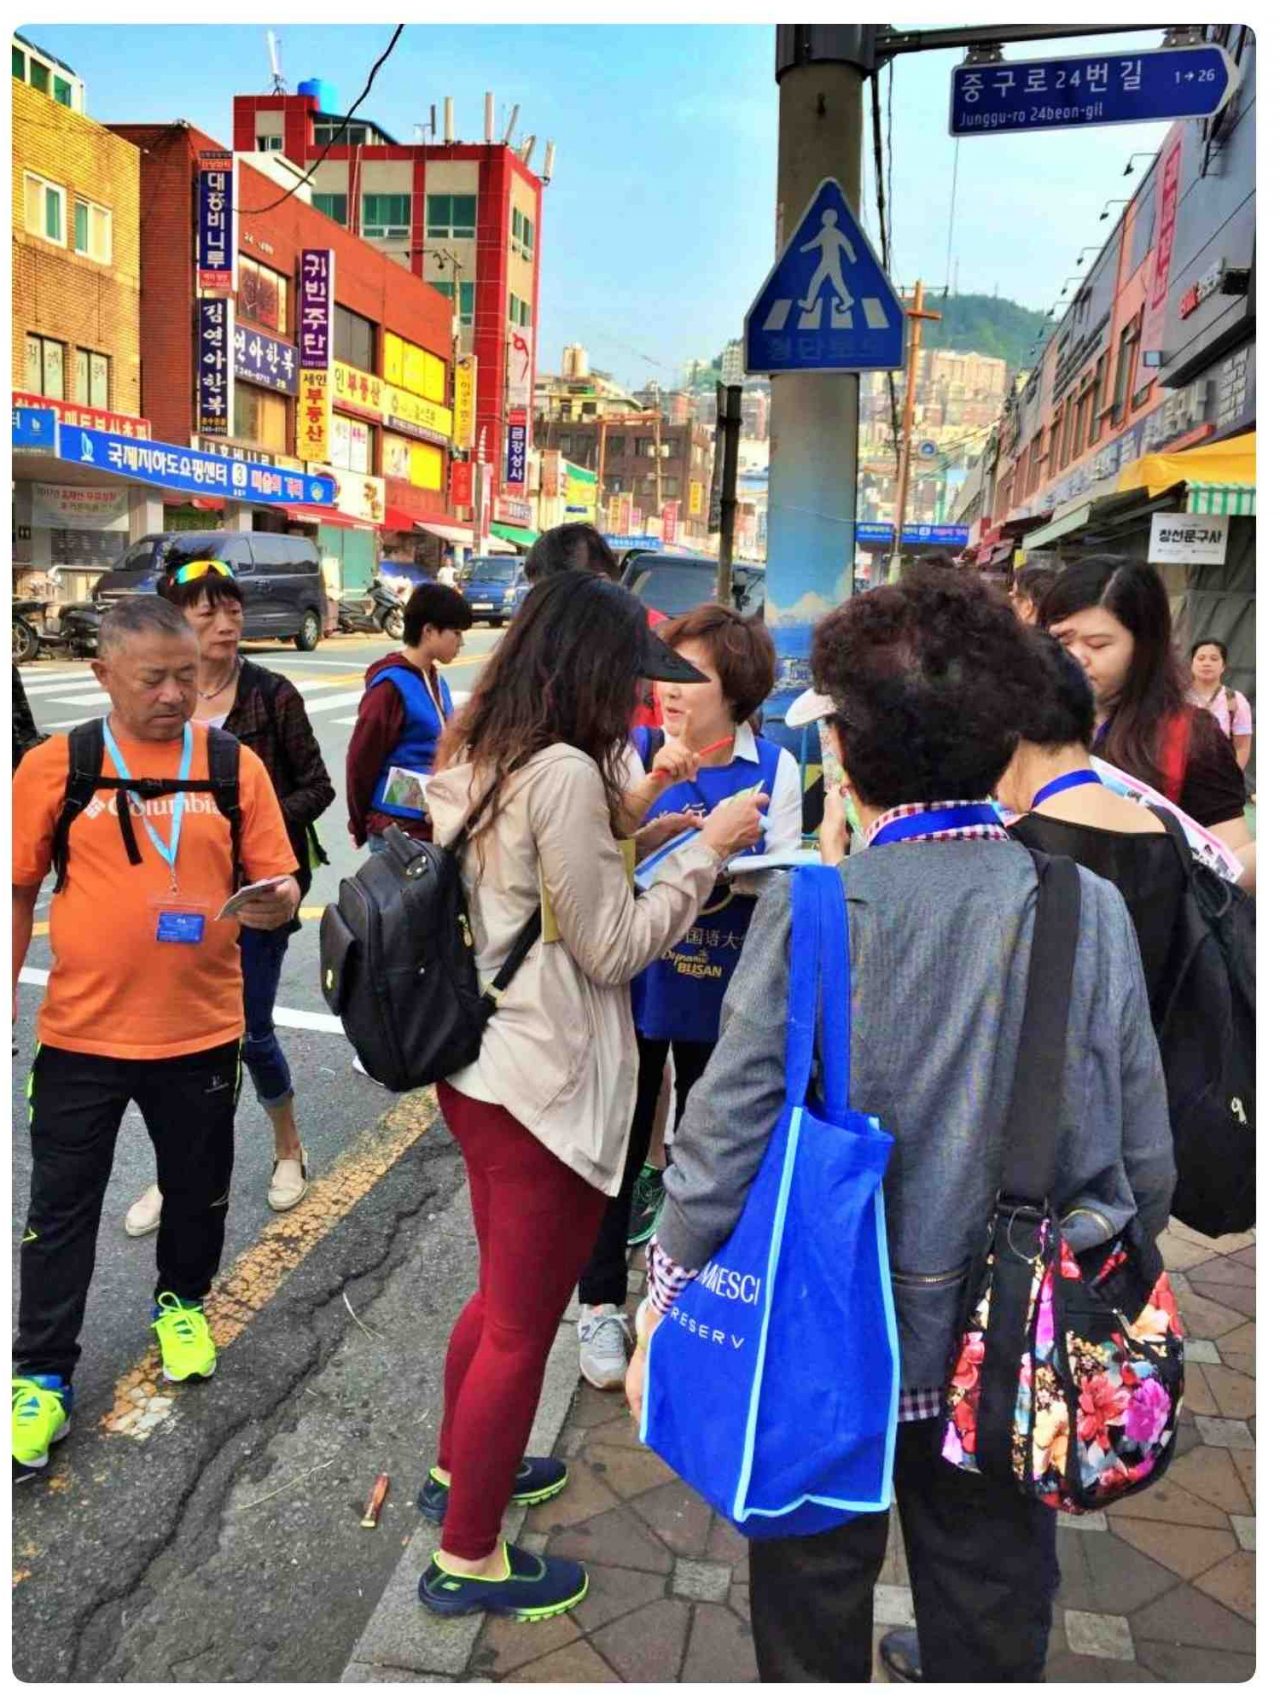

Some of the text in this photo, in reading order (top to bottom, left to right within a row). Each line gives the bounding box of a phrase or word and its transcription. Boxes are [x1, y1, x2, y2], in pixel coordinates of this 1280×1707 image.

[961, 59, 1142, 103] 중구로24번길
[1198, 68, 1216, 82] 26
[959, 101, 1103, 128] Junggu-ro 24beon-gil
[302, 253, 328, 356] 귀빈주단
[202, 302, 226, 416] 김연아한복
[234, 329, 295, 380] 연아한복
[347, 372, 380, 407] 부동산
[306, 388, 324, 443] 부동산
[107, 441, 228, 486] 국제지하도쇼핑센터
[1158, 528, 1222, 544] 창선문구사
[677, 961, 722, 978] BUSAN
